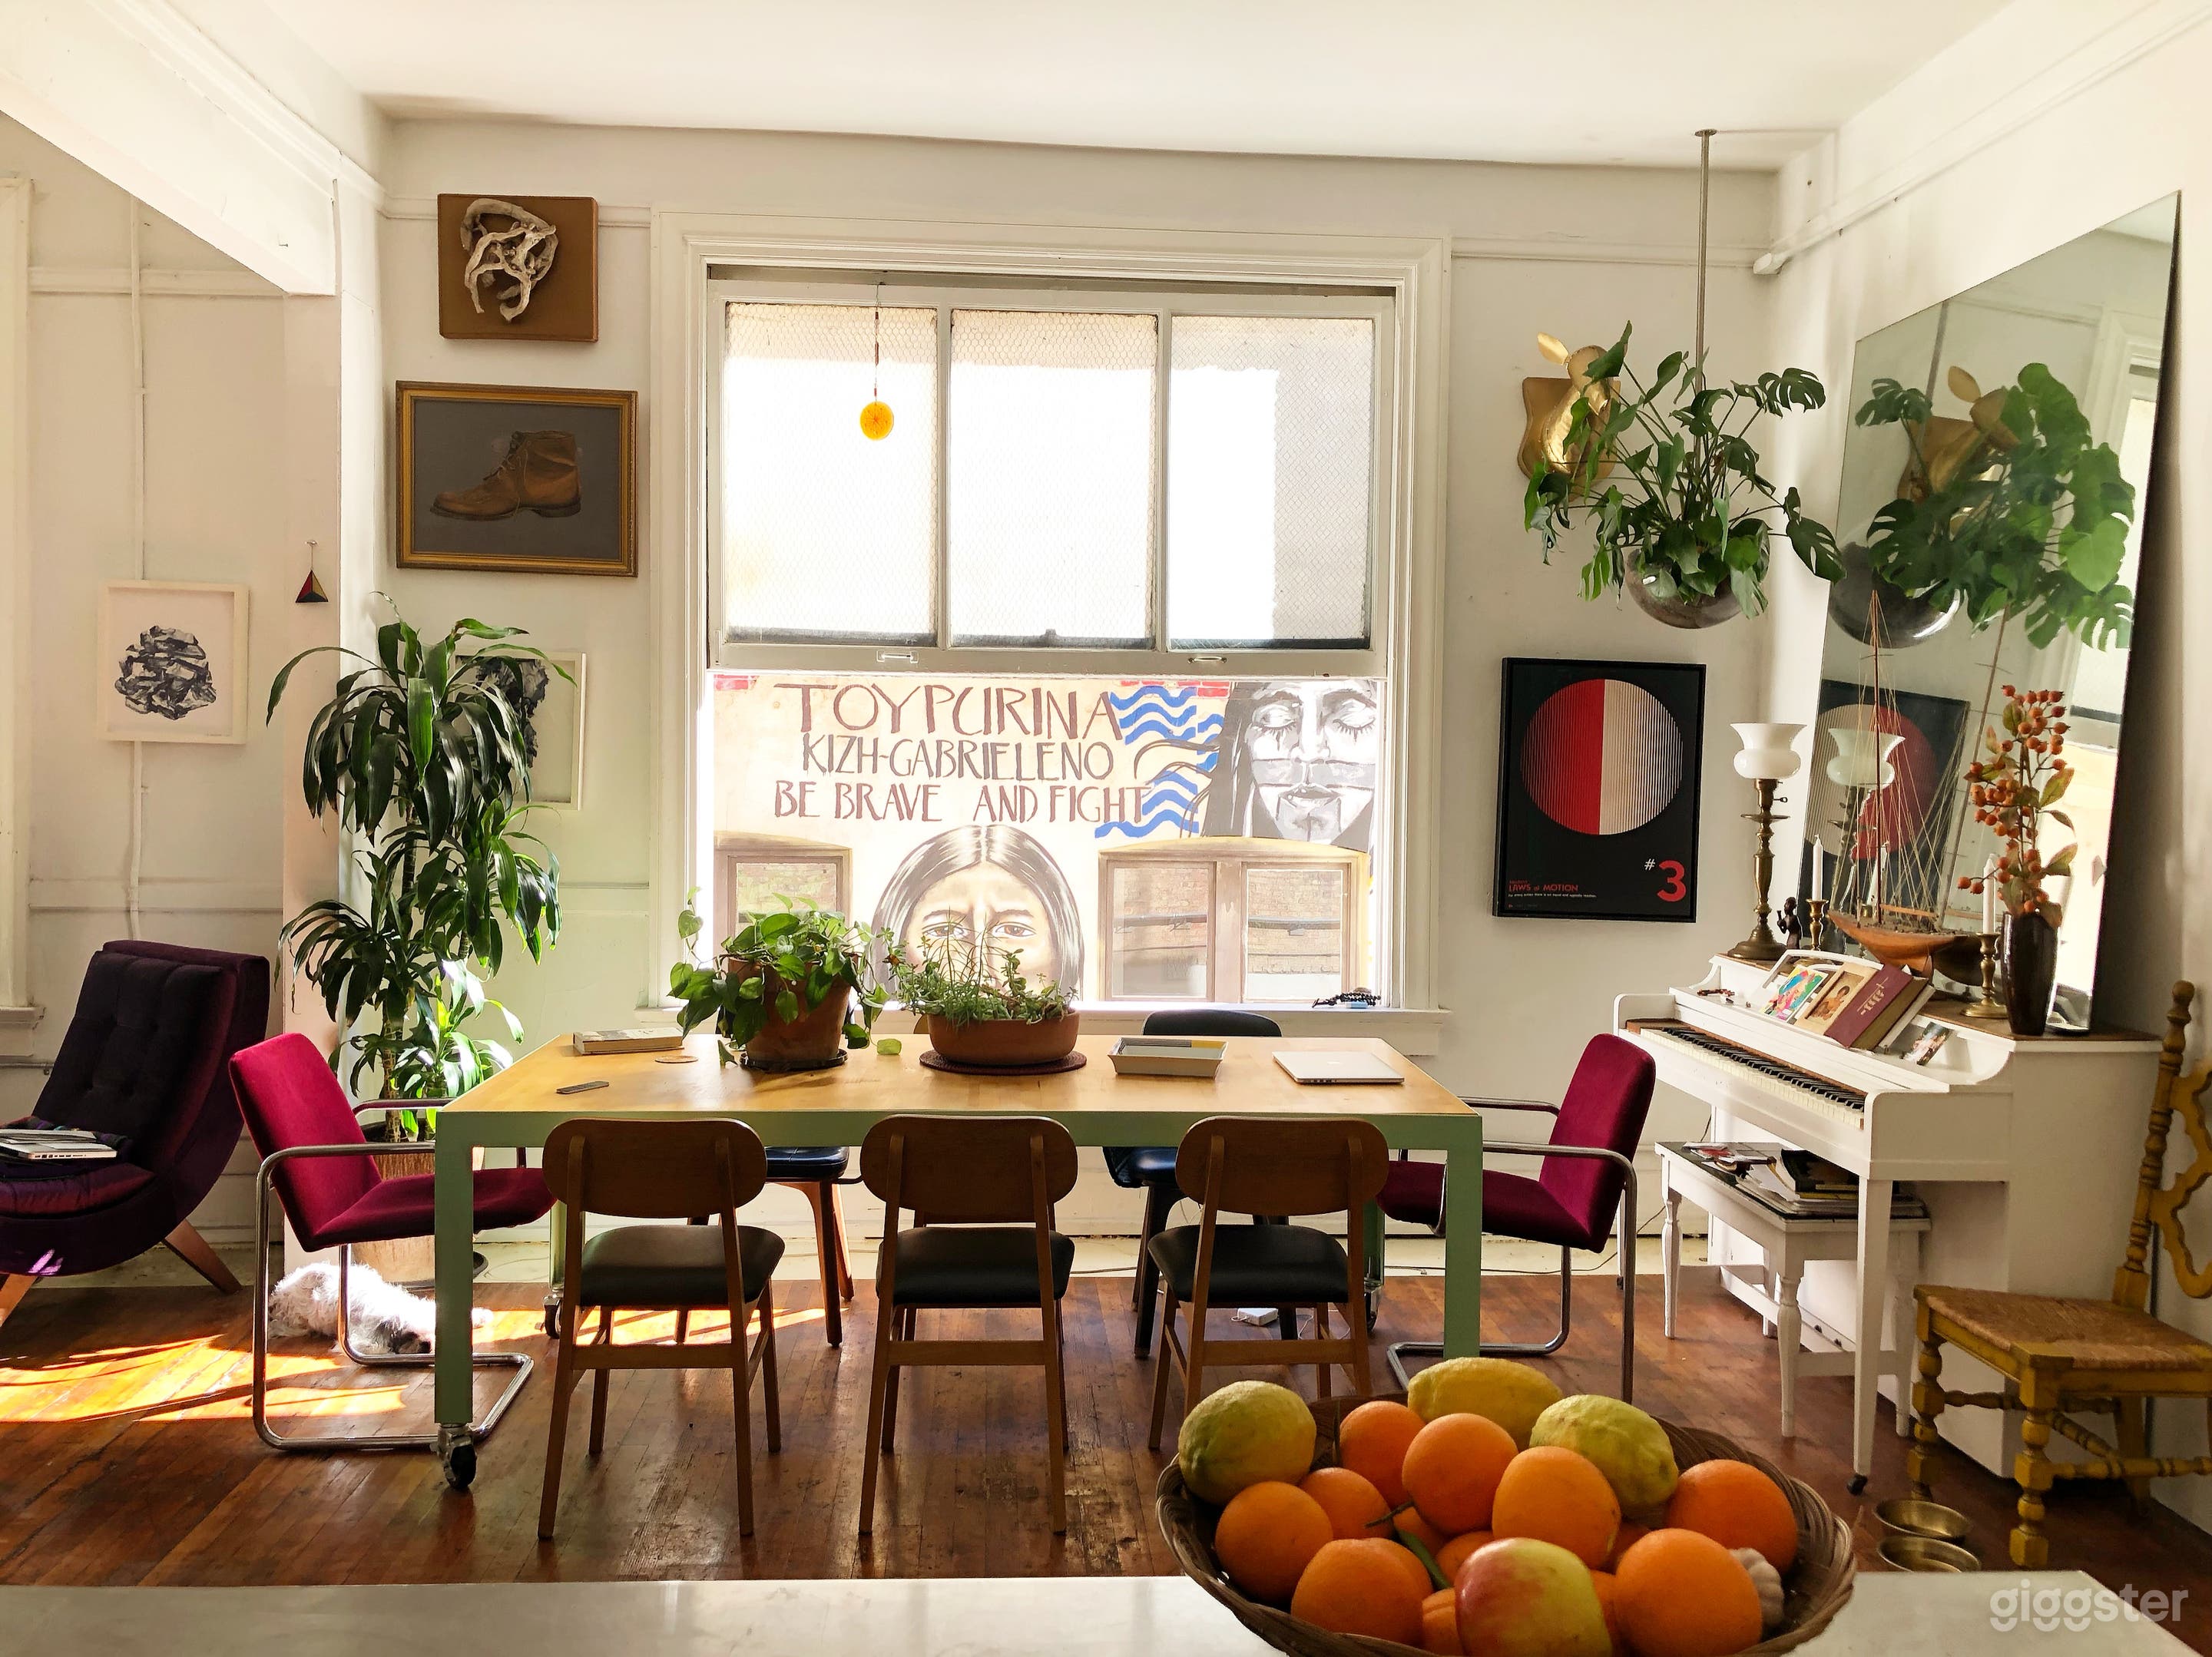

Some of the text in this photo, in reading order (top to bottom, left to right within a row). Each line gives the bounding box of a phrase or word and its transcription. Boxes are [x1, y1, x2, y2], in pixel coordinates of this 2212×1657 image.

[773, 683, 1123, 740] TOYPURINA
[803, 733, 1114, 781] KIZH-GABRIELENO
[774, 779, 1151, 824] BE BRAVE AND FIGHT
